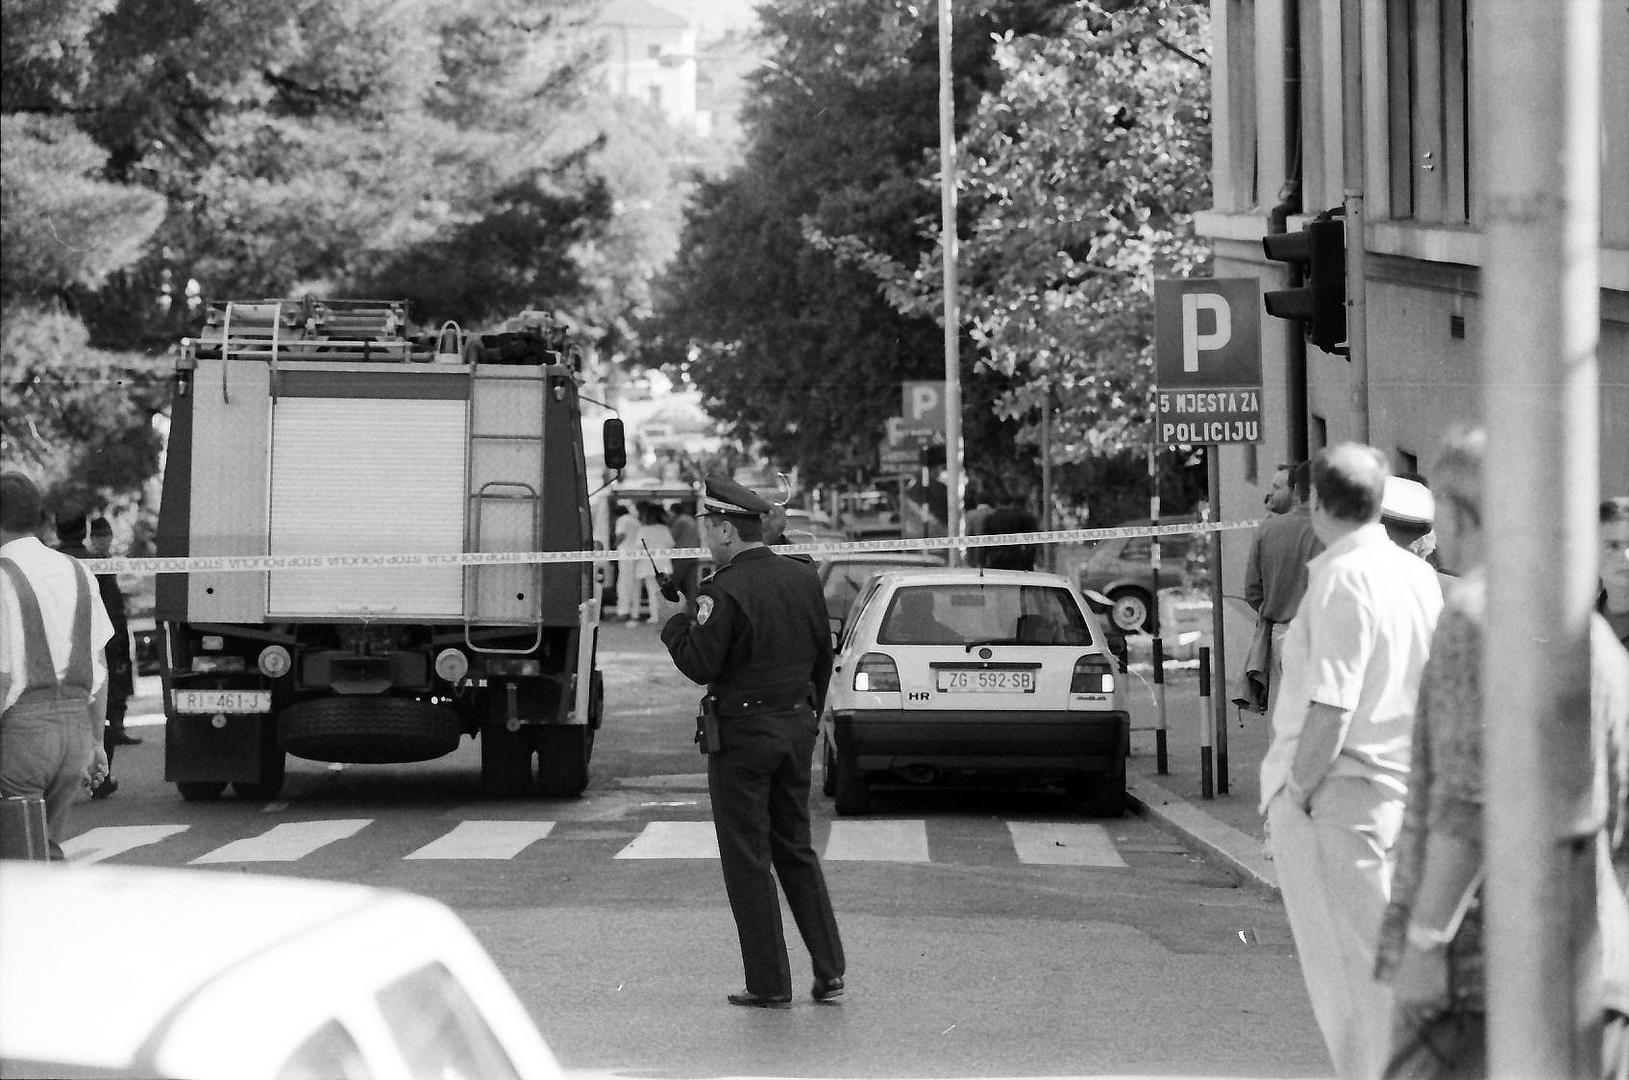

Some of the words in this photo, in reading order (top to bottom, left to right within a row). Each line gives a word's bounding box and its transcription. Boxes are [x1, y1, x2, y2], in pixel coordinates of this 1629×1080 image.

[1182, 293, 1232, 373] P
[913, 387, 938, 420] P
[1160, 394, 1170, 413] 5
[1176, 392, 1238, 413] MJESTA
[1240, 391, 1259, 412] ZA
[1162, 421, 1258, 442] POLICIJU
[949, 673, 968, 688] ZG
[908, 692, 930, 701] HR
